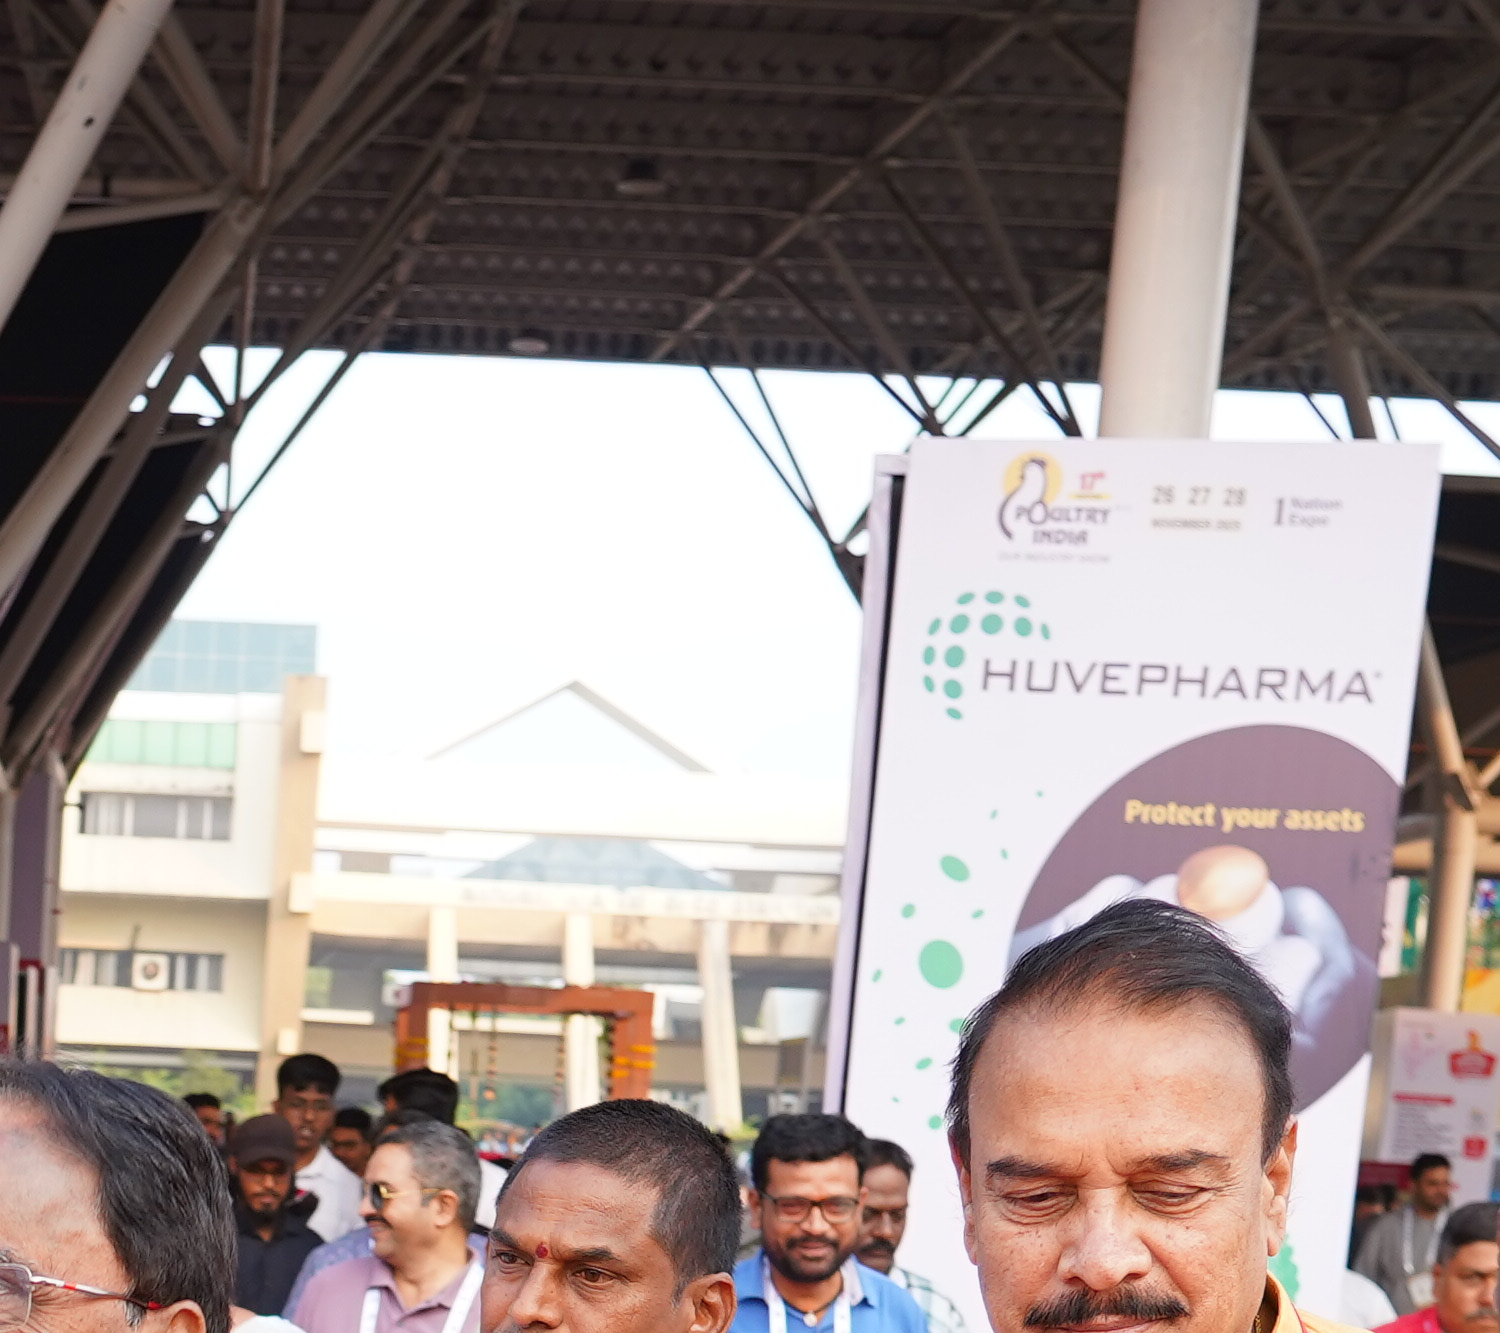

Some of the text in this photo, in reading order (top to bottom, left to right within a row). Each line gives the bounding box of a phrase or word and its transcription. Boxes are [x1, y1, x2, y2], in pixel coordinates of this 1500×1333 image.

[1187, 485, 1212, 505] 27
[1014, 500, 1111, 525] POULTRY
[1033, 529, 1088, 546] INDIA
[982, 658, 1374, 703] HUVEPHARMA
[1123, 799, 1366, 833] Protect your assets
